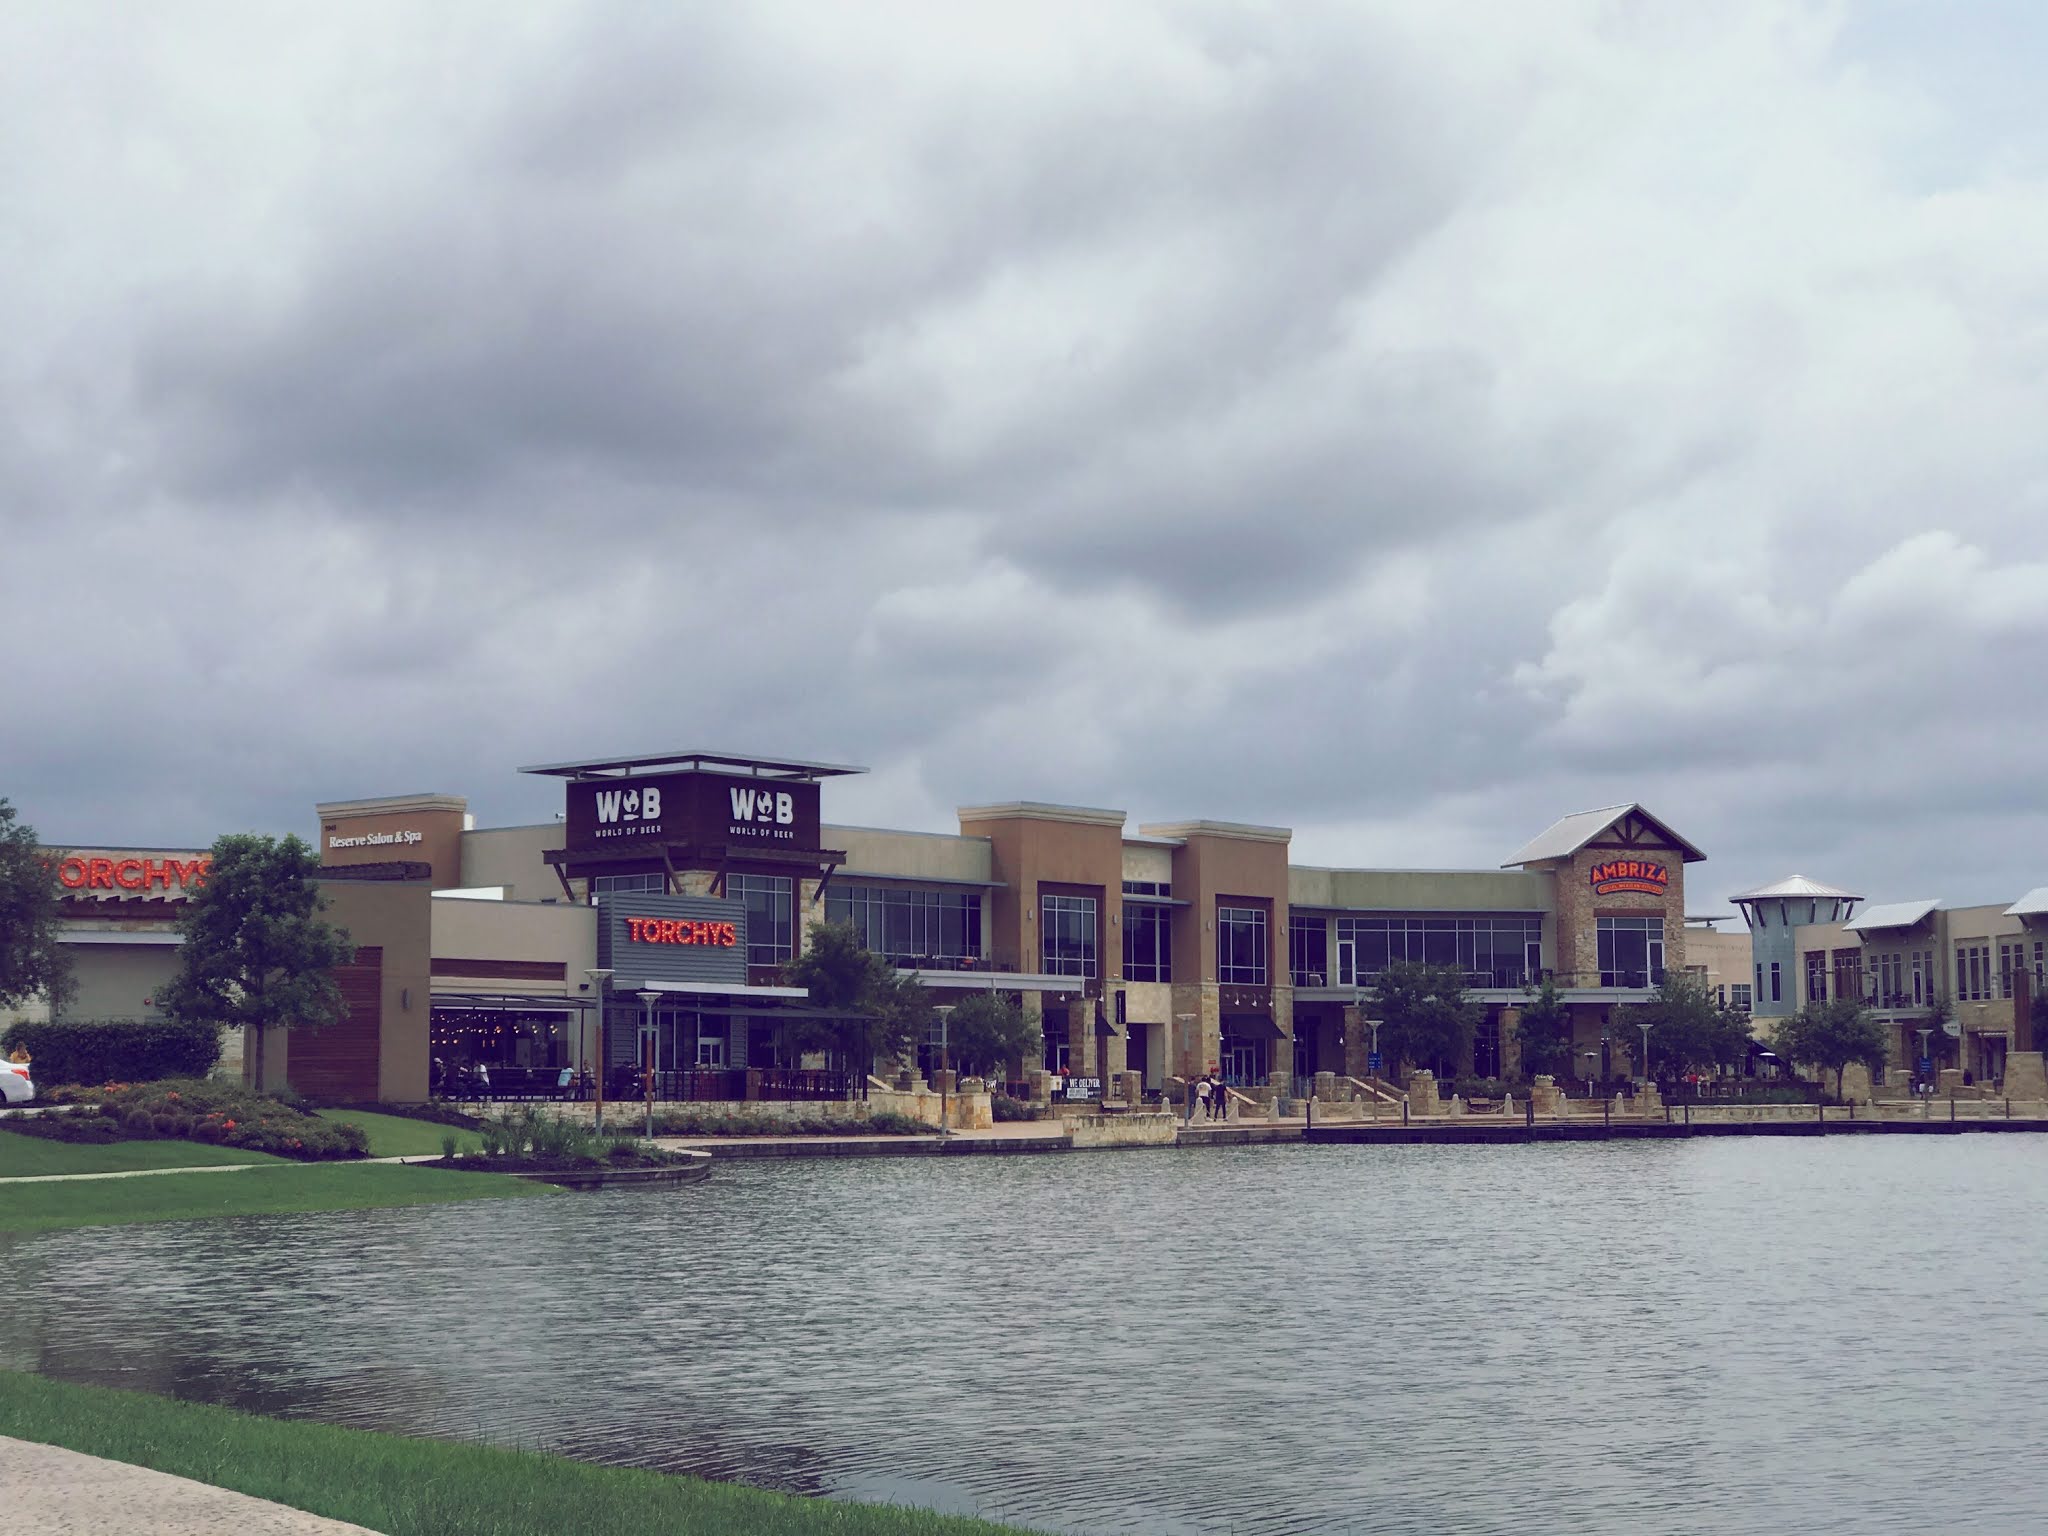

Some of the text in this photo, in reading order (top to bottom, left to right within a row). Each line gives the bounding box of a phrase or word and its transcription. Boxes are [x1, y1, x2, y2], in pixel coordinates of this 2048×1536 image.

[329, 830, 422, 848] Reserve Salon & Spa
[595, 825, 661, 838] WORLD OF BEER
[730, 826, 794, 839] WORLD OF BEER
[40, 857, 212, 890] ORCHYS
[1592, 862, 1668, 884] AMBRIZA
[625, 918, 736, 946] TORCHYS
[1069, 1078, 1101, 1088] WE DELIVER
